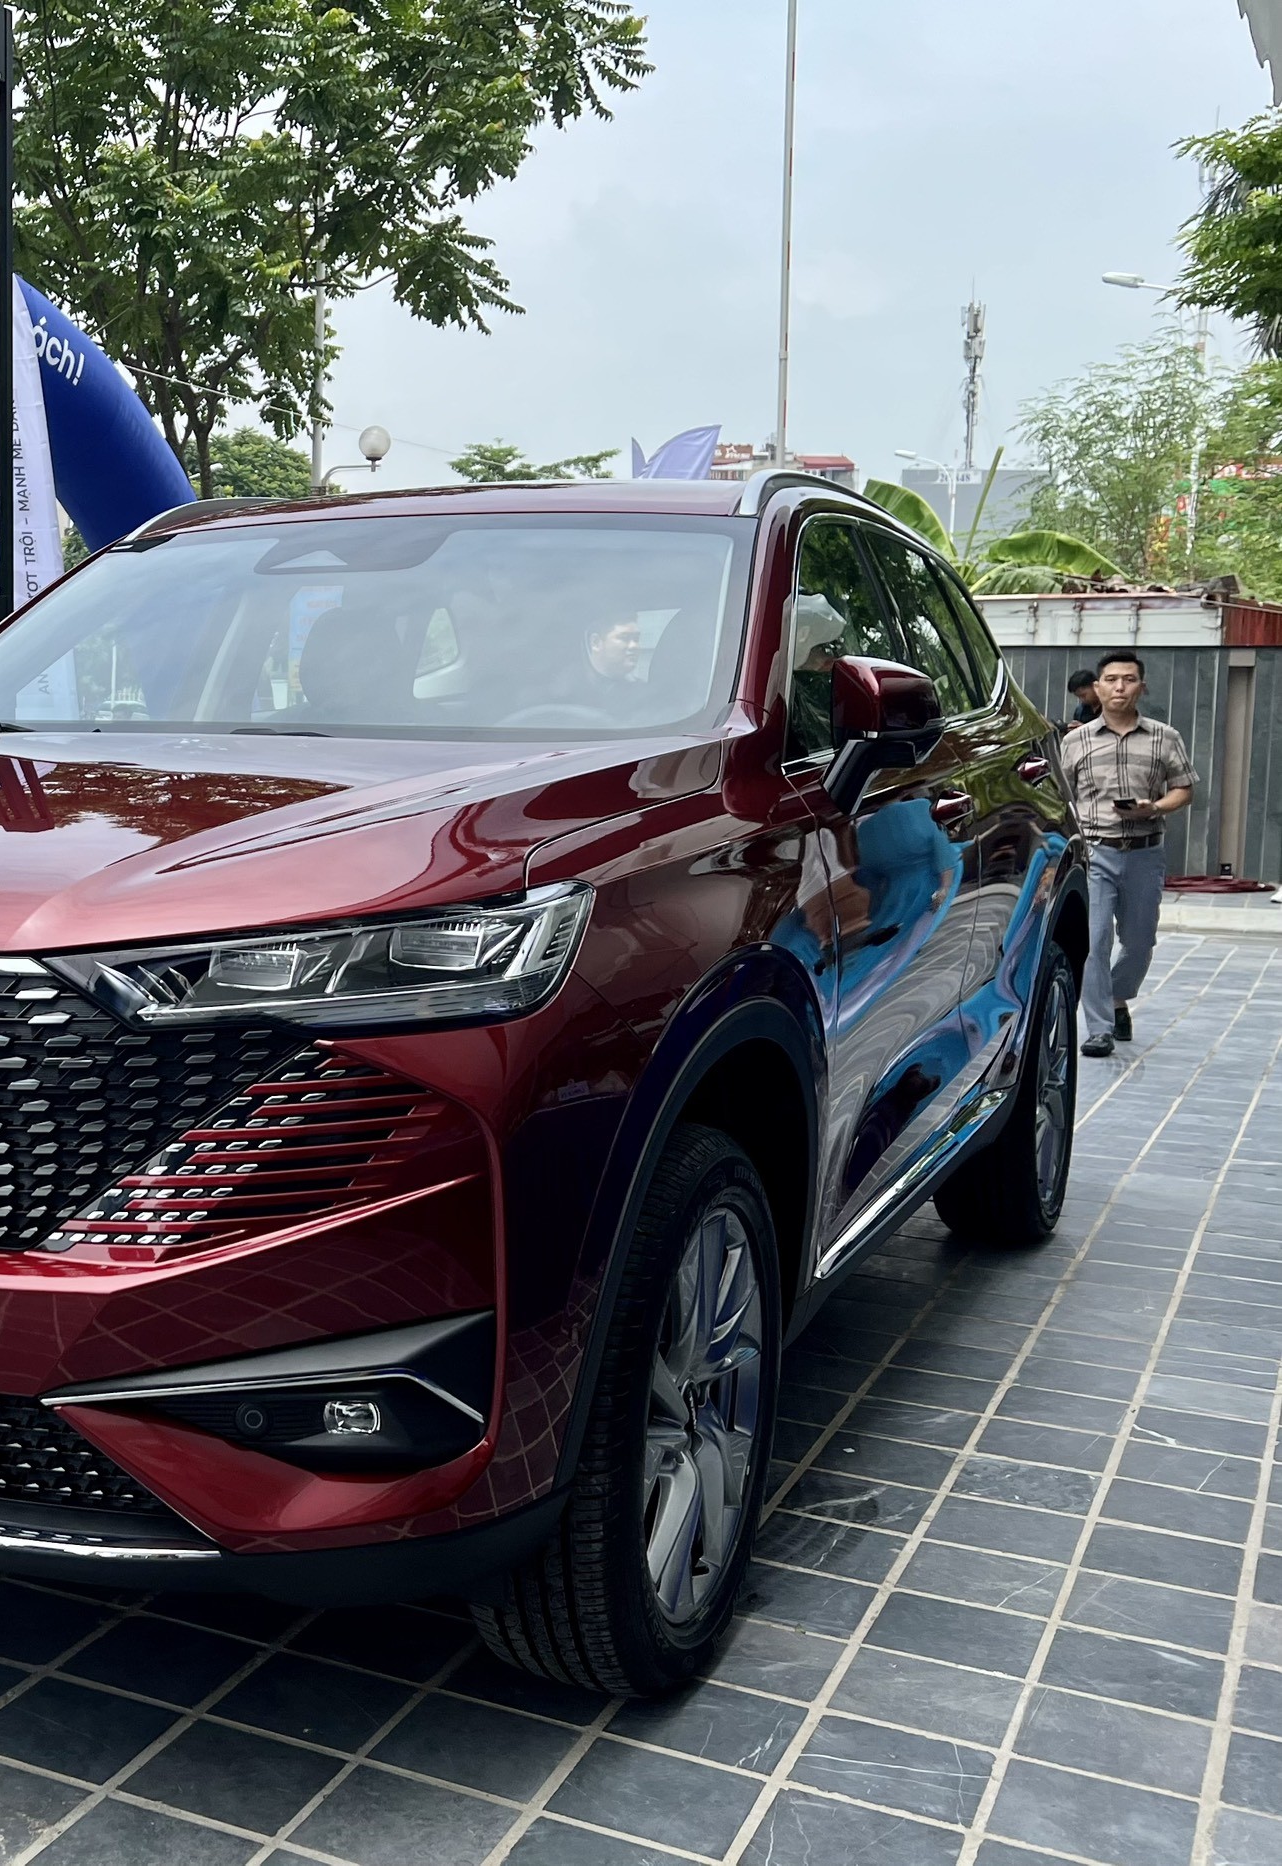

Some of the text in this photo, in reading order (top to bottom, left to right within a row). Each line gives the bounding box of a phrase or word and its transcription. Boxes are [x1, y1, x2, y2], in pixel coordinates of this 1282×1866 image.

[32, 315, 85, 386] ách!
[14, 466, 32, 512] MẠNH
[19, 531, 37, 566] TRỘI
